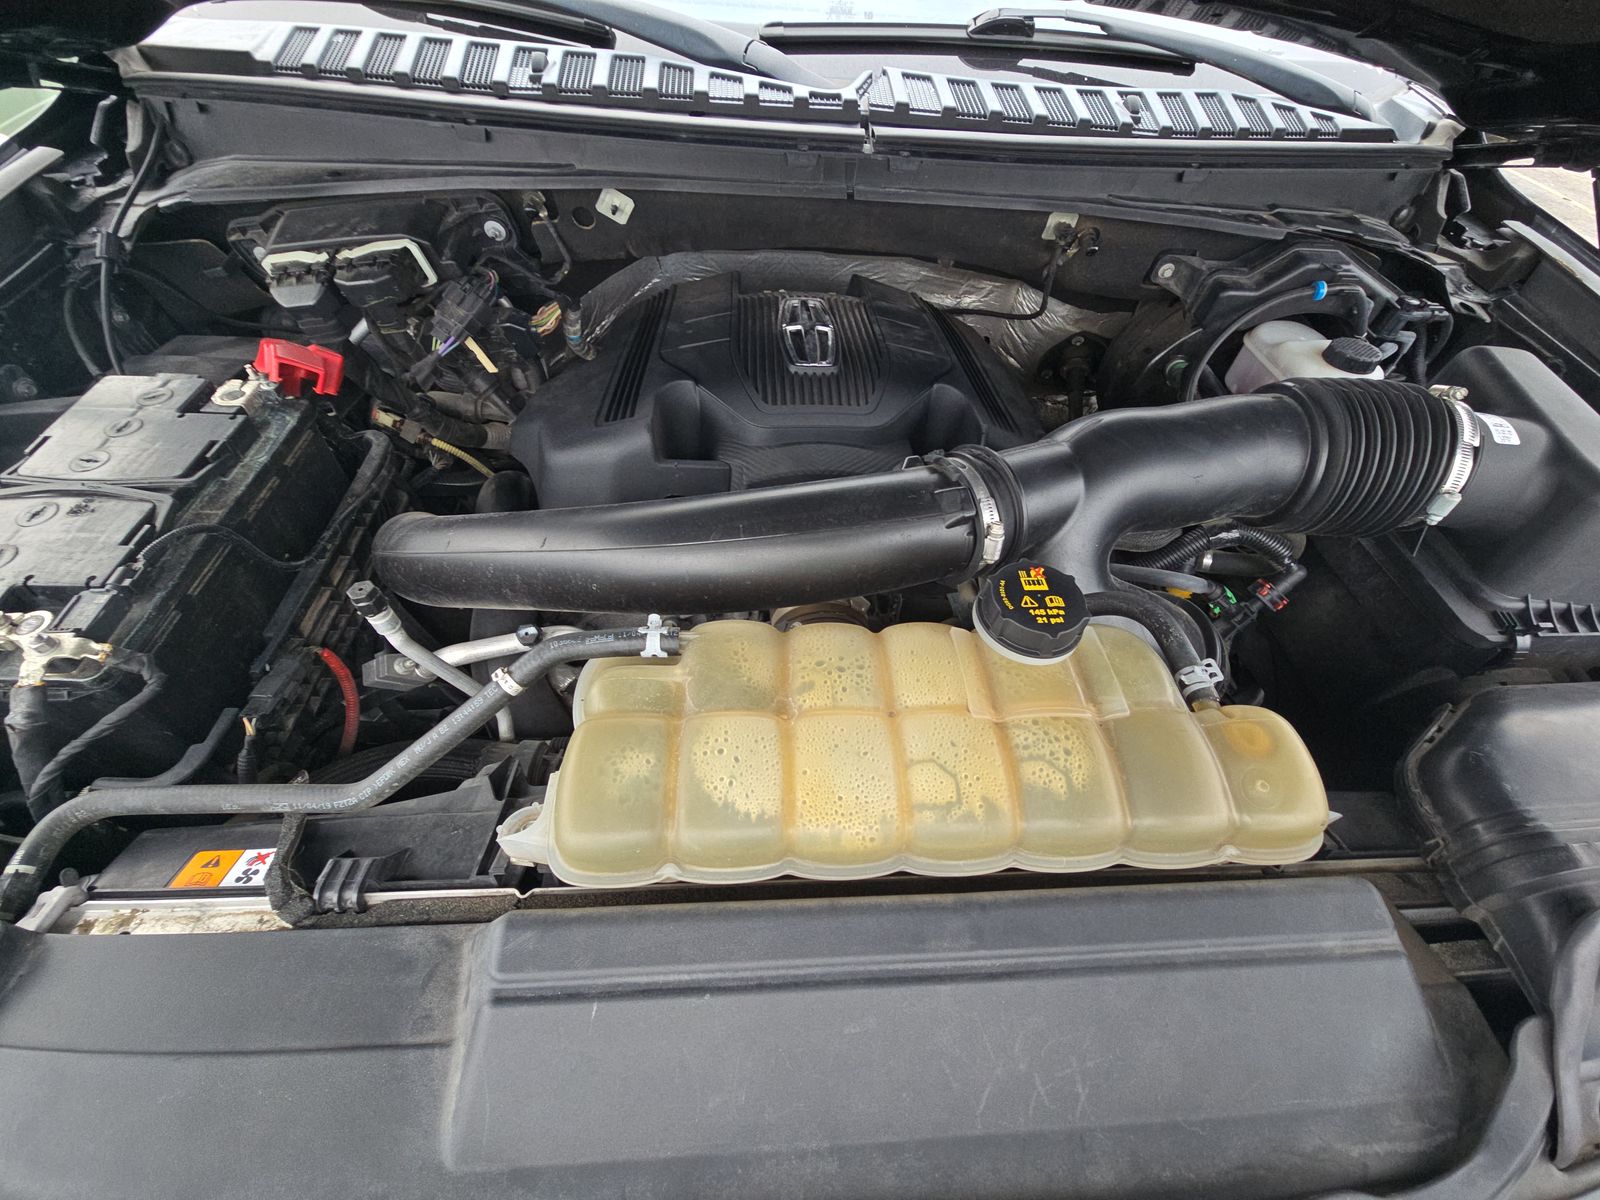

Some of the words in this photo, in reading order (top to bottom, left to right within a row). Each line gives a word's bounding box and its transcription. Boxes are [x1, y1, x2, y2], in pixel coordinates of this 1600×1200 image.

[1029, 608, 1047, 616] 145
[1047, 608, 1066, 616] kPa
[1036, 616, 1048, 624] 21
[1050, 616, 1065, 625] psi
